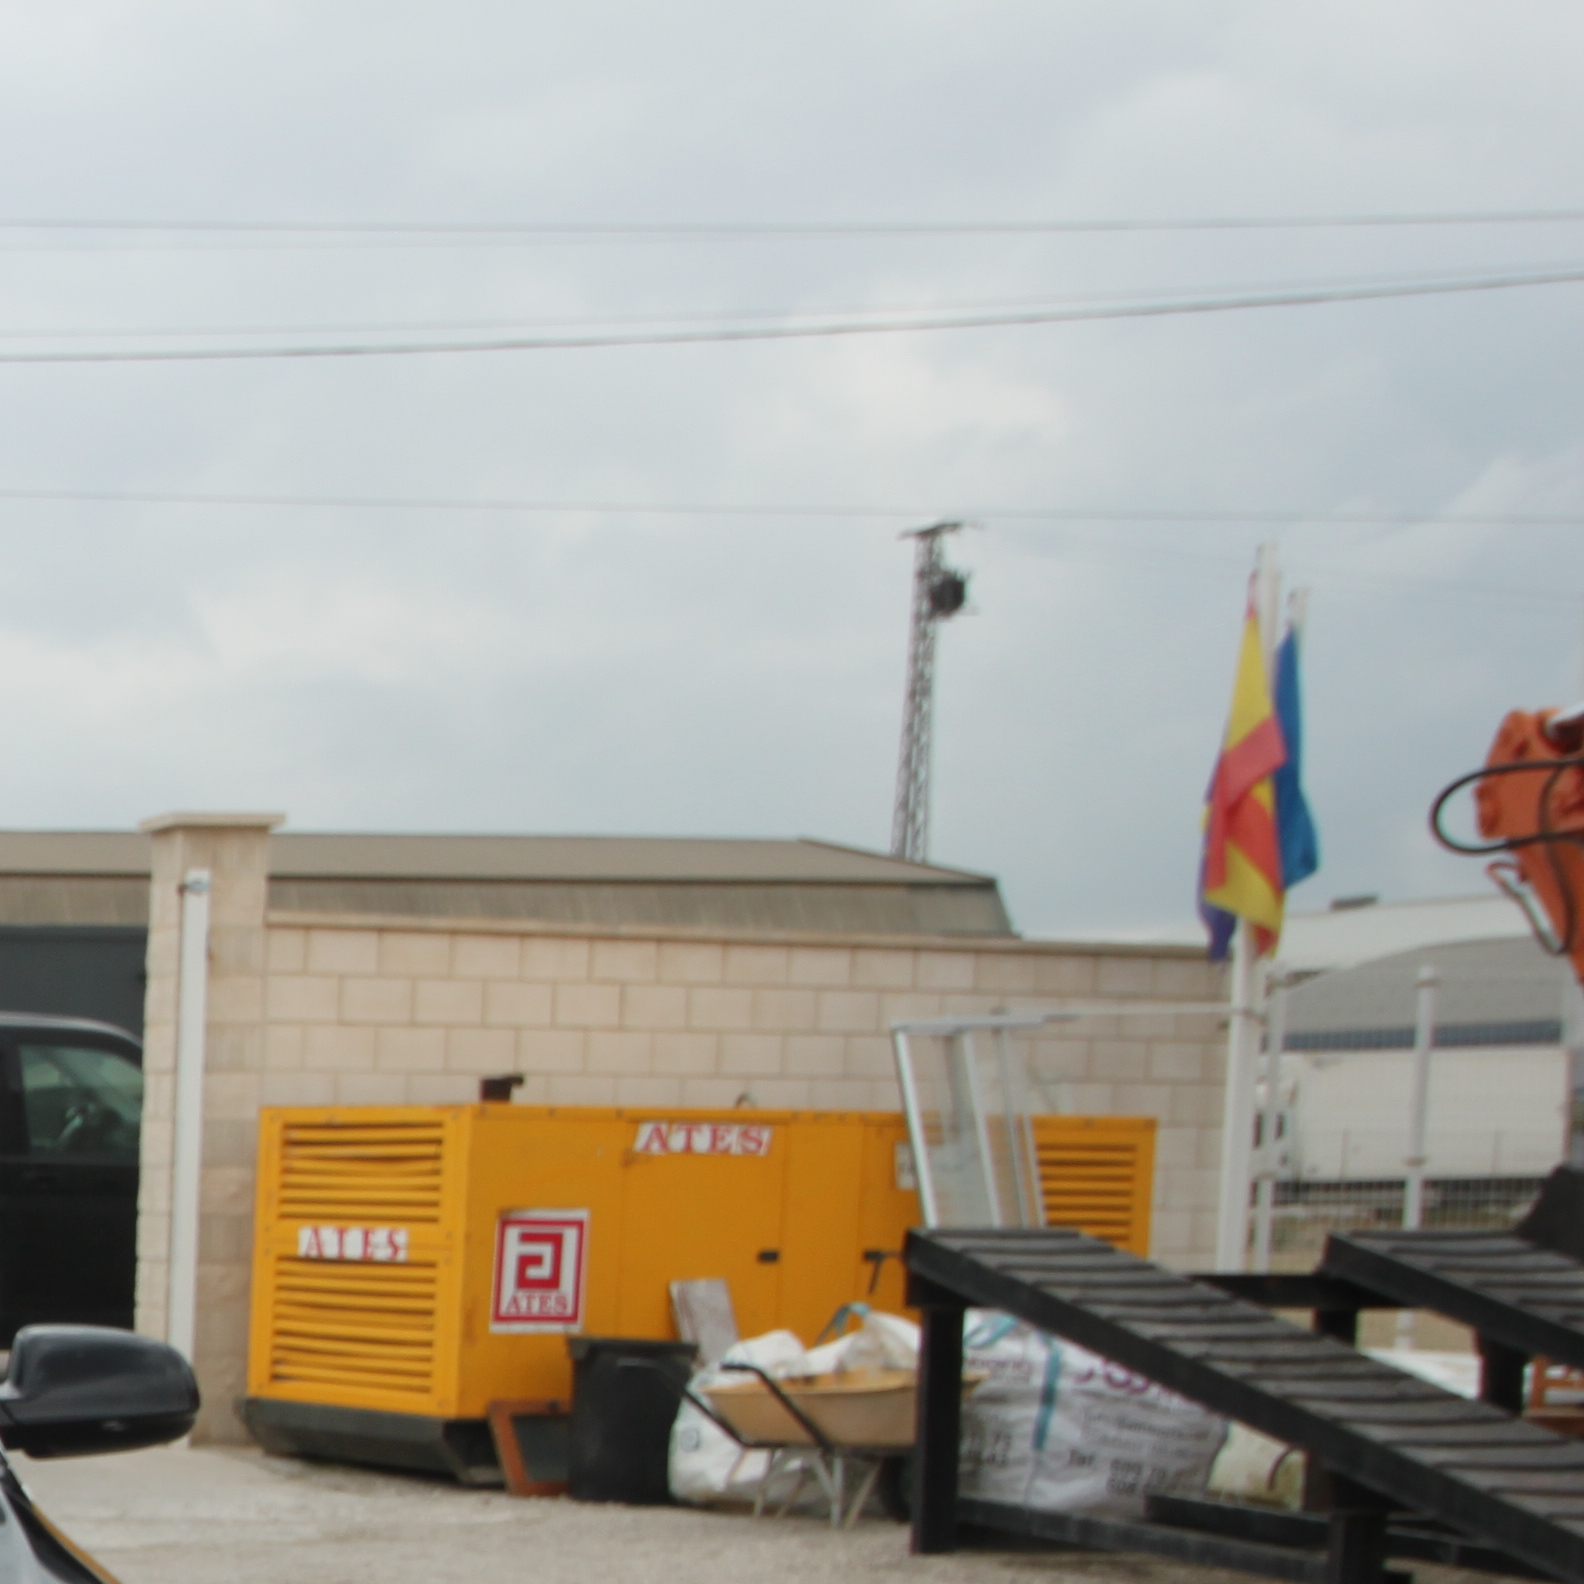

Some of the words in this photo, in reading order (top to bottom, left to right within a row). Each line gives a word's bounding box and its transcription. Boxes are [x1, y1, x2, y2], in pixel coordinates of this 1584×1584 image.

[639, 1125, 770, 1154] ATES
[304, 1227, 403, 1259] ATES
[506, 1293, 570, 1317] ATES
